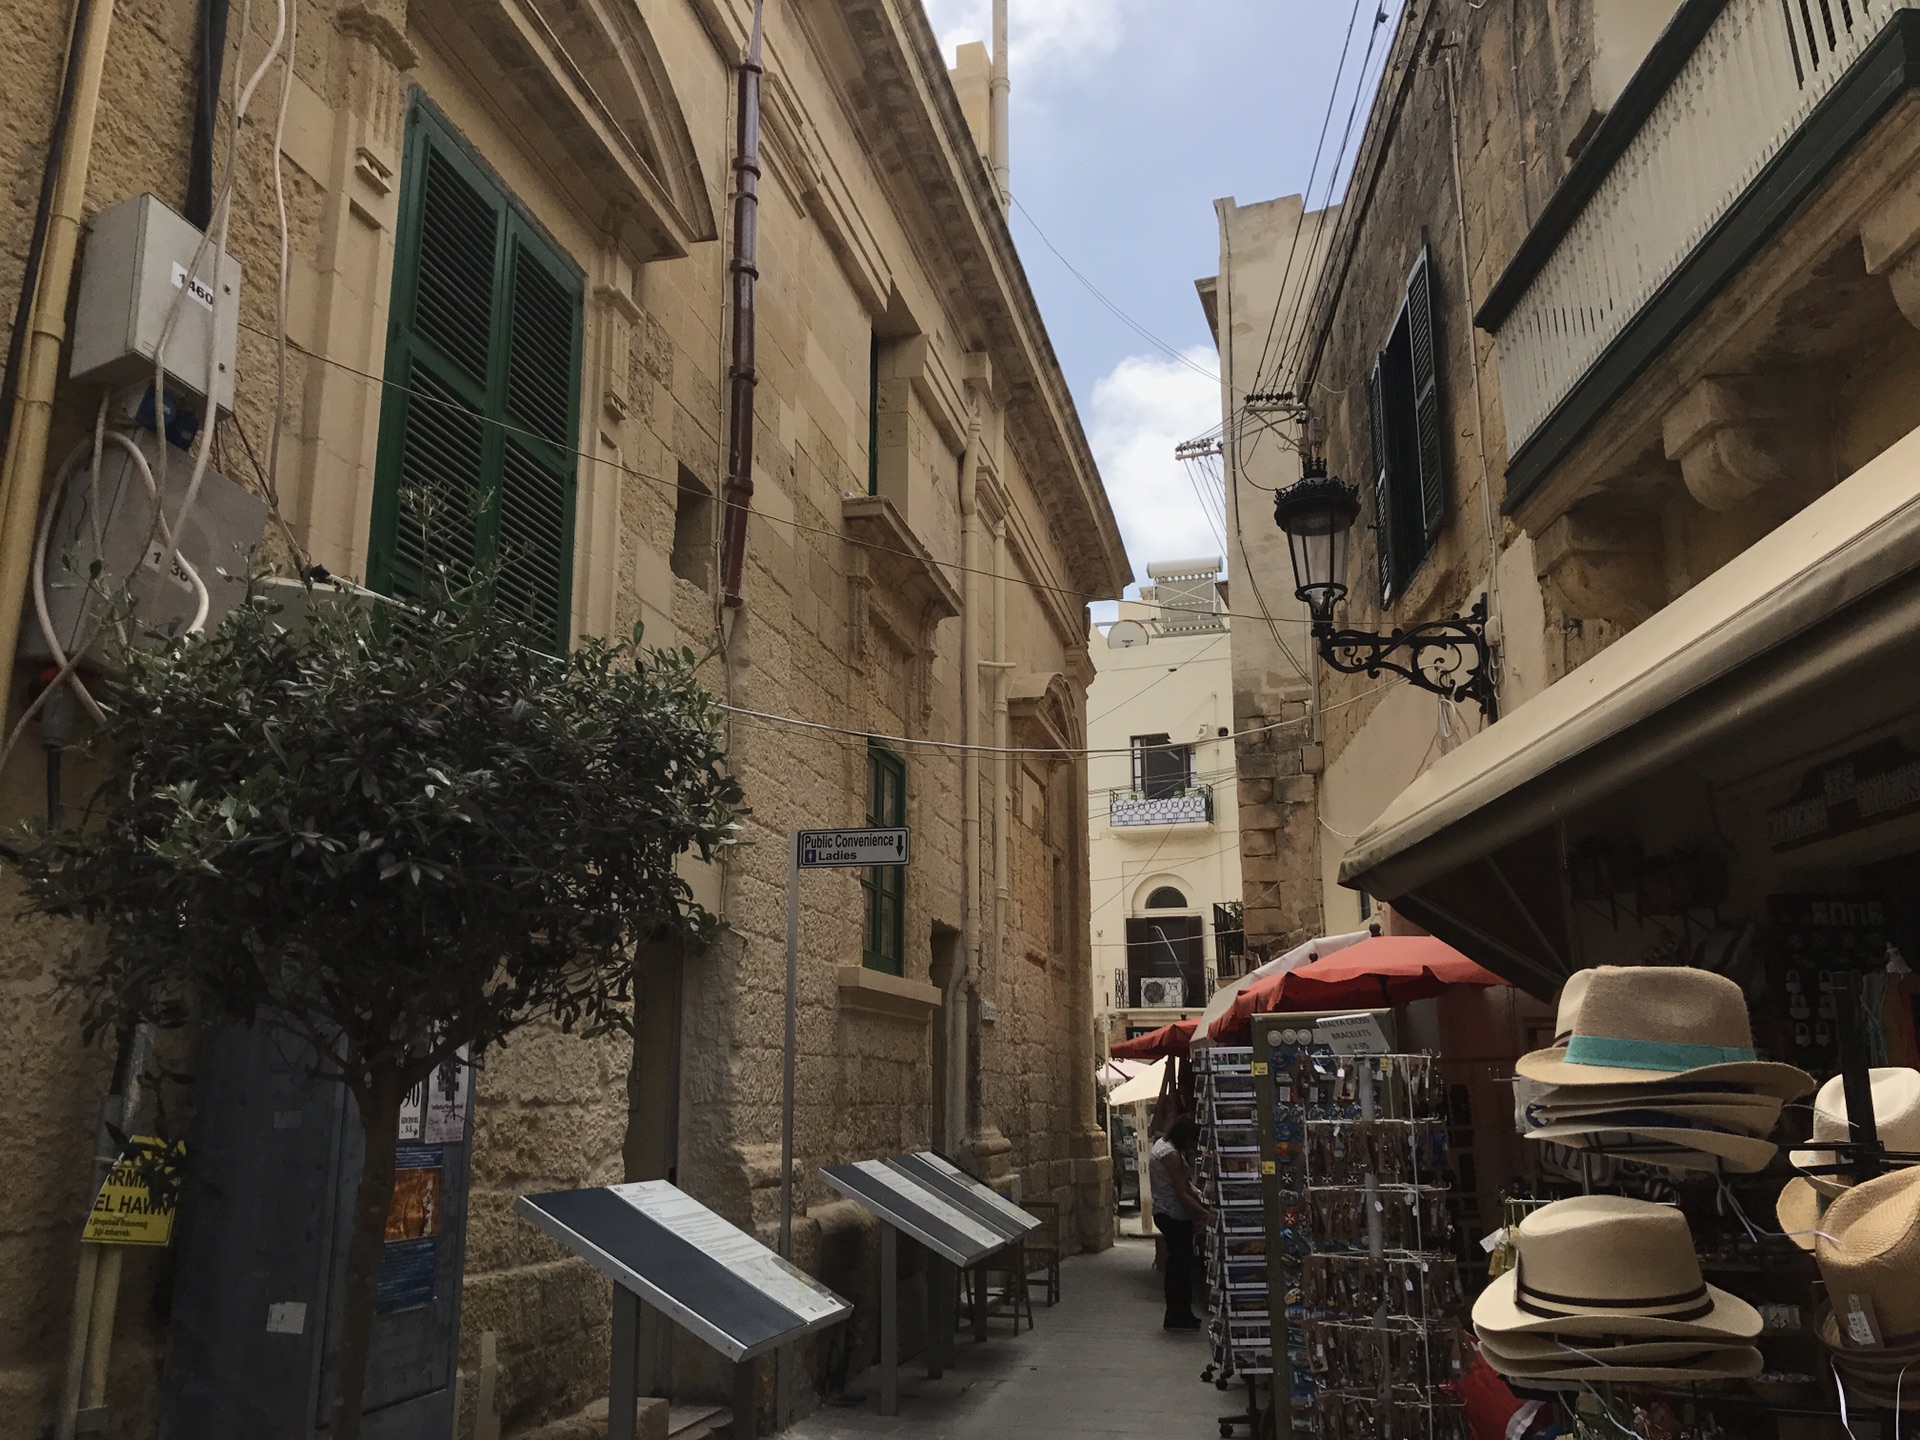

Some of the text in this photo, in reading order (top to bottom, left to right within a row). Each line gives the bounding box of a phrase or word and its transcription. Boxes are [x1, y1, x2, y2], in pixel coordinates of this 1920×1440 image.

[804, 833, 894, 849] Public Convenience
[818, 850, 857, 861] Ladies
[1318, 1016, 1371, 1029] MALTA CROSS
[1330, 1029, 1372, 1040] BRACELETS
[93, 1194, 115, 1212] EL
